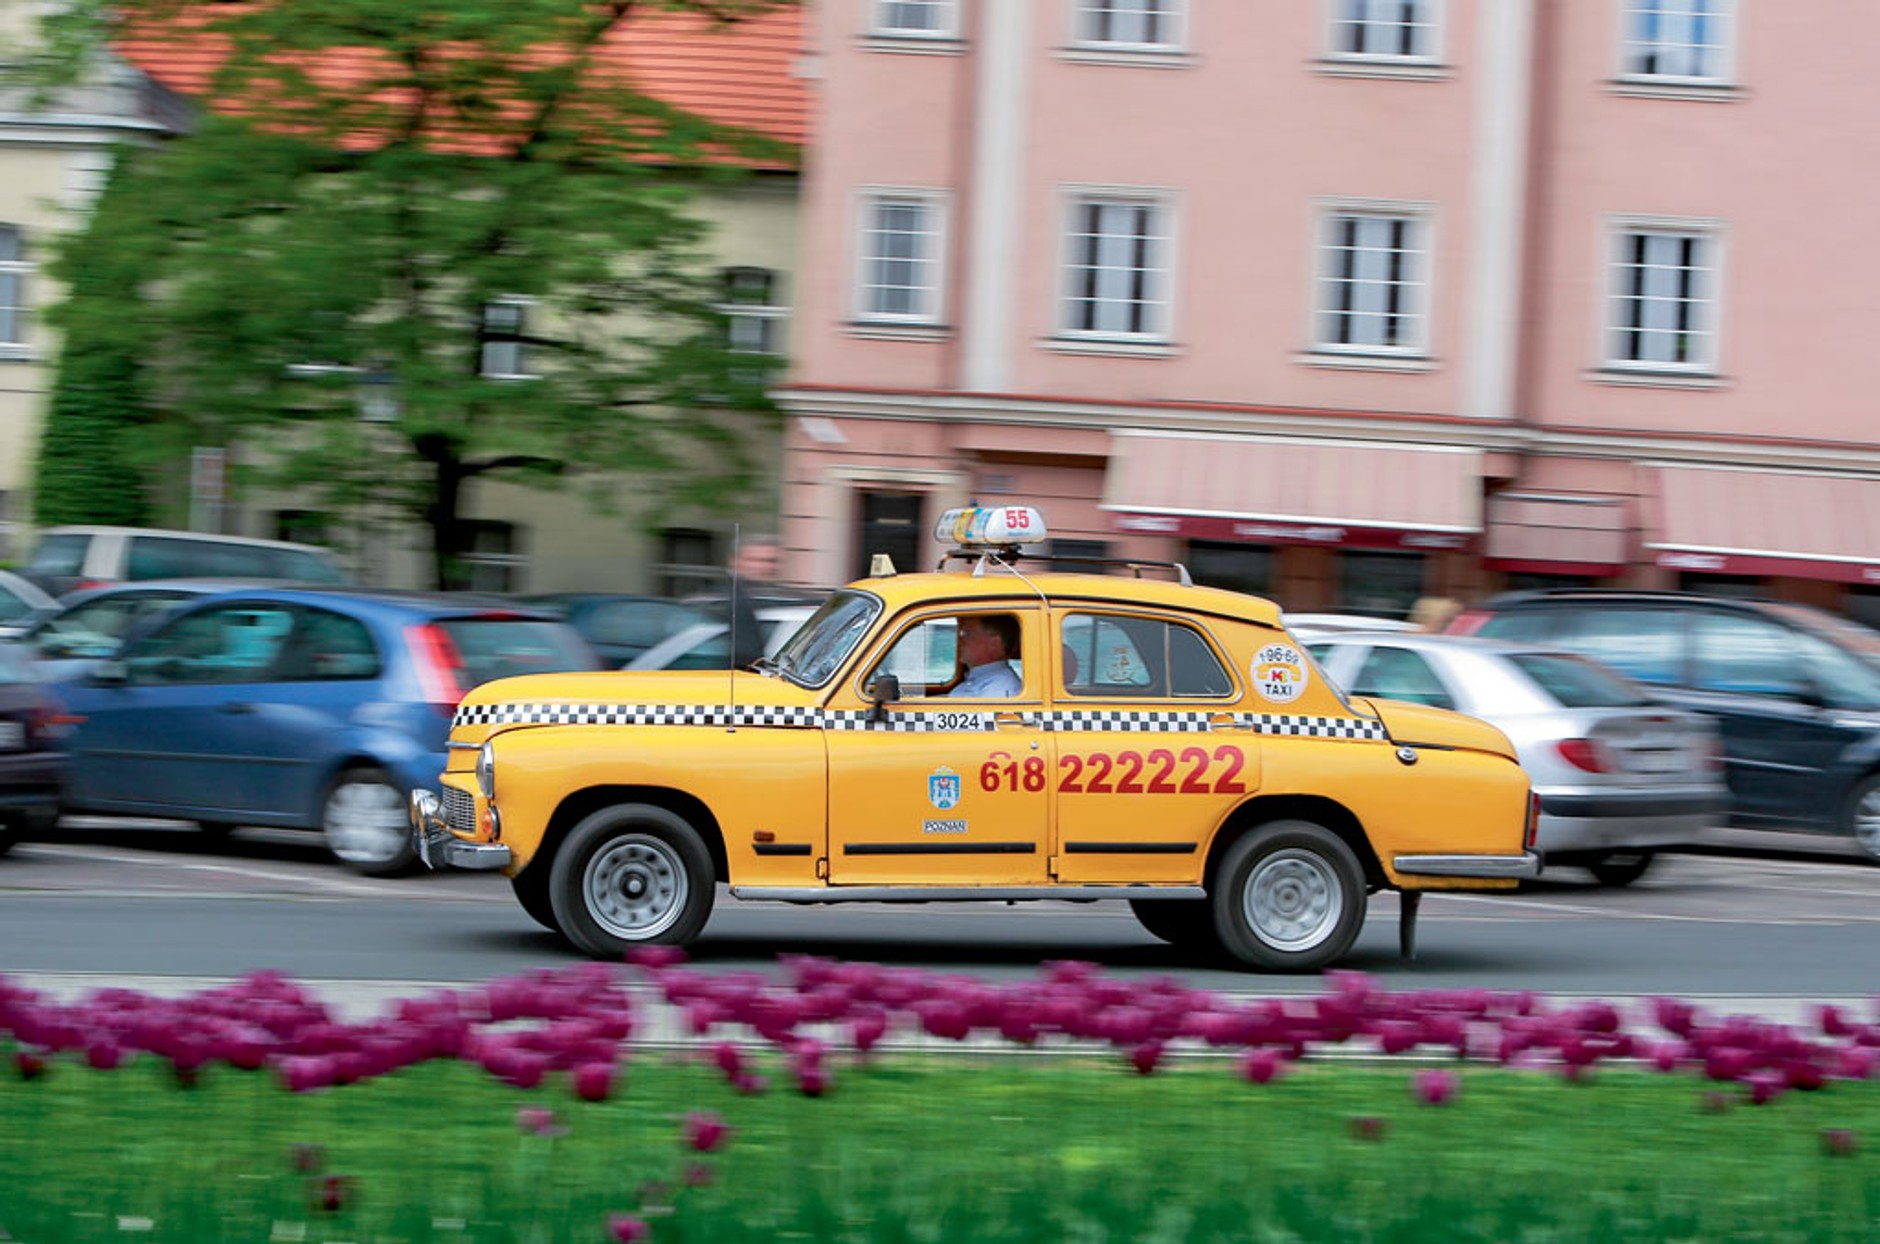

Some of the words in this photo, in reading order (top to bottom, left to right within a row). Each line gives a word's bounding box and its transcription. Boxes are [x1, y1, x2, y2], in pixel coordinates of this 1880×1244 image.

[1005, 510, 1029, 529] 55
[1265, 684, 1292, 696] TAXI
[938, 713, 980, 730] 3024
[980, 756, 1046, 792] 618
[1058, 745, 1246, 794] 222222
